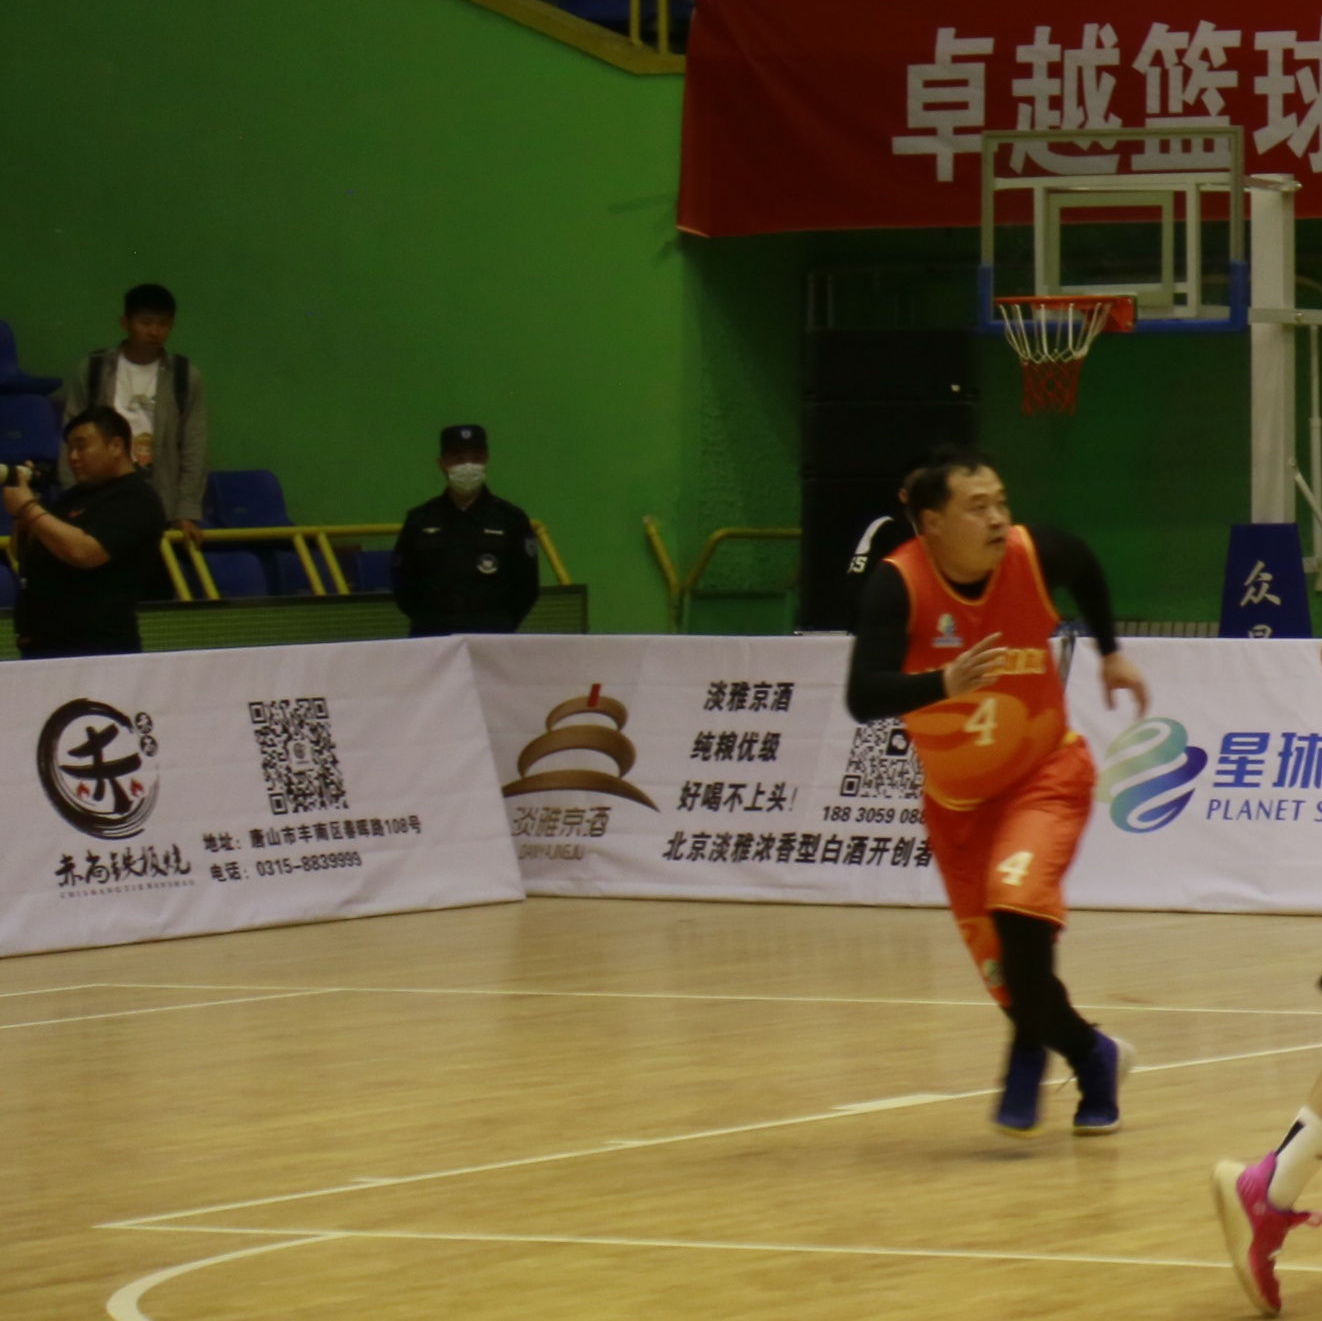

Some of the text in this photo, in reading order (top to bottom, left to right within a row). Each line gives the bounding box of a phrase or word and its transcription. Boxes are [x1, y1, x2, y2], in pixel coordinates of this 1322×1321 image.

[703, 681, 794, 712] 淡雅京酒
[963, 697, 999, 746] 4
[690, 731, 781, 762] 纯粮优级
[822, 806, 851, 822] 188
[855, 807, 895, 824] 3059
[1206, 798, 1305, 821] PLANET
[662, 831, 933, 868] 北京淡雅浓香型白酒开创者
[997, 850, 1034, 886] 4
